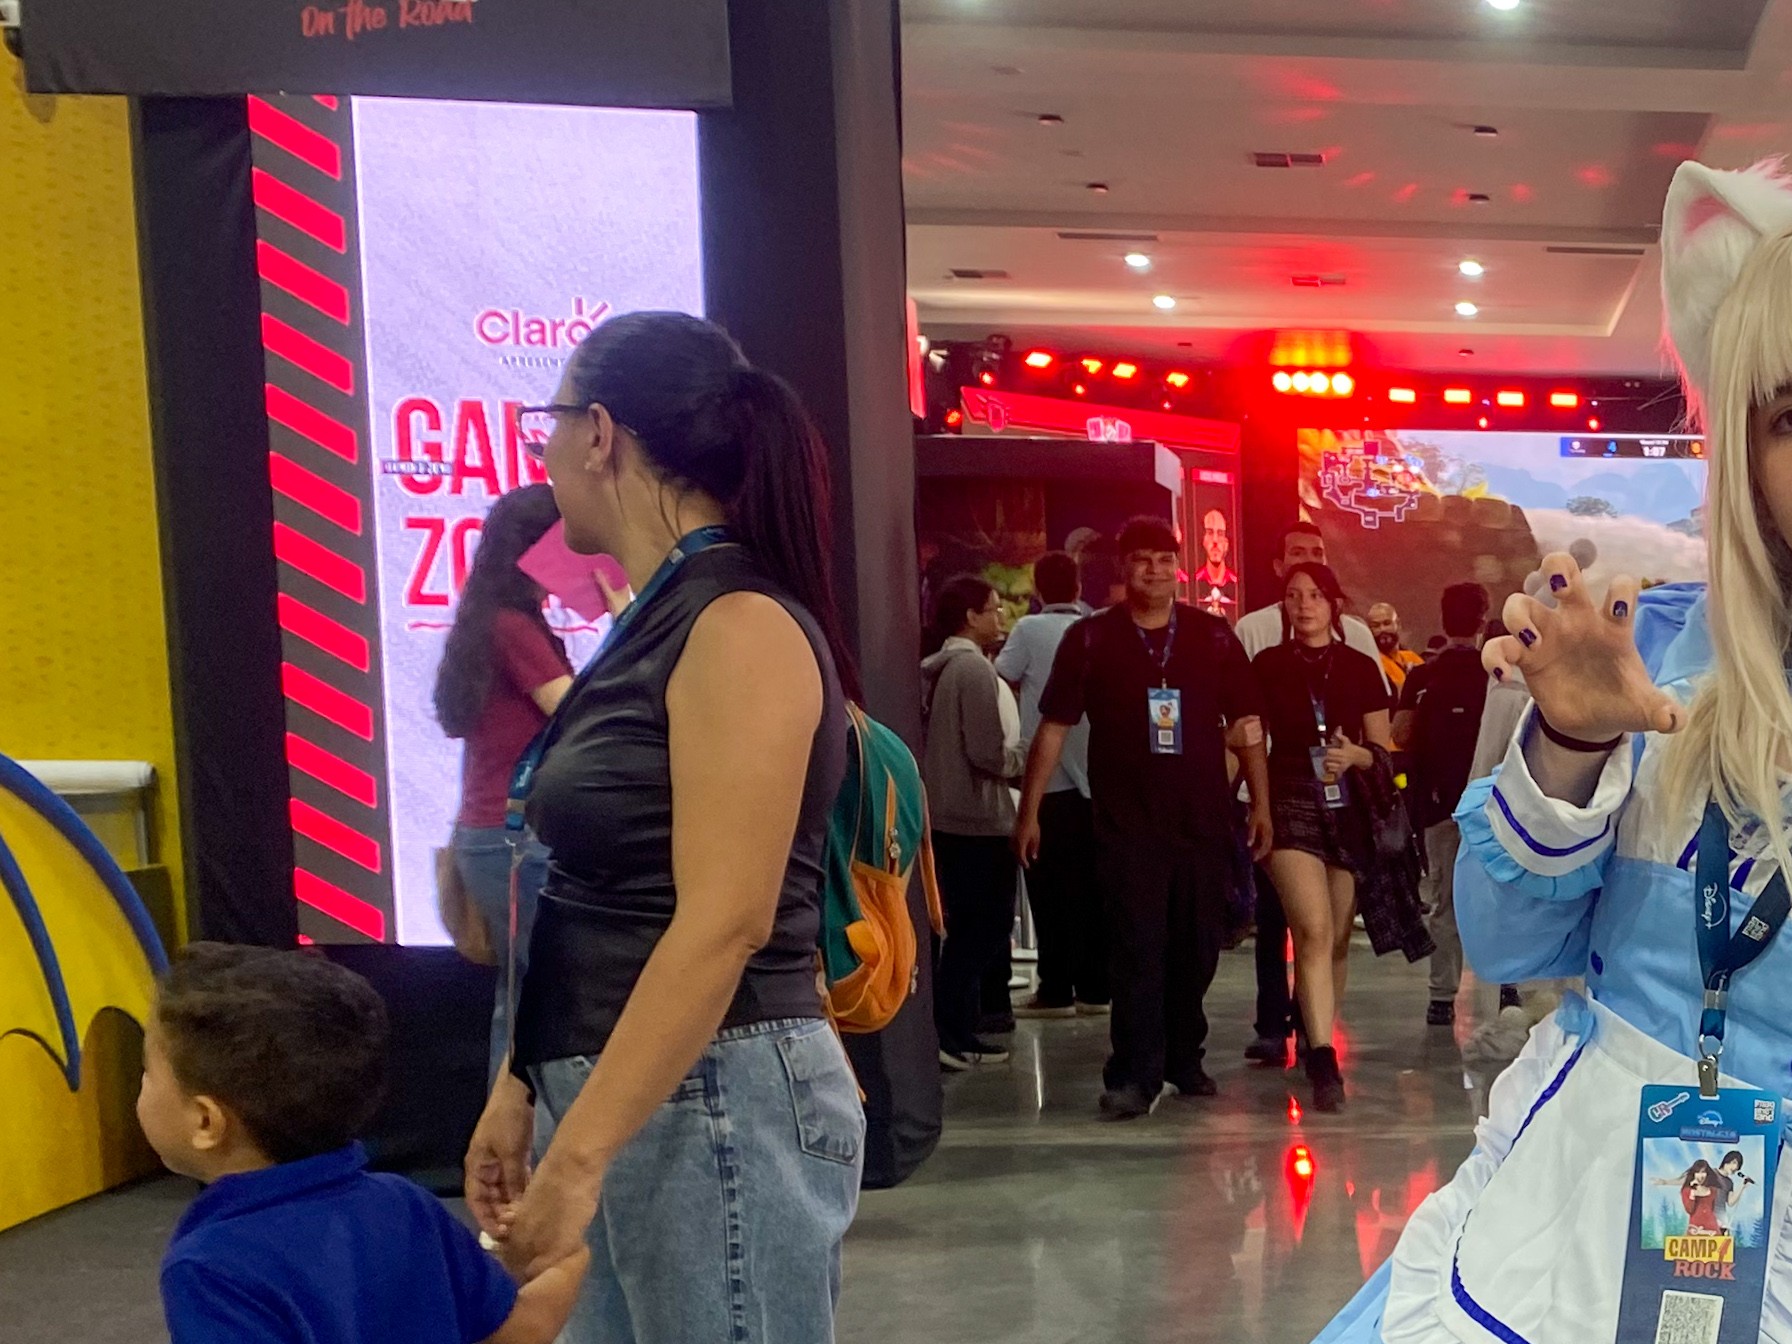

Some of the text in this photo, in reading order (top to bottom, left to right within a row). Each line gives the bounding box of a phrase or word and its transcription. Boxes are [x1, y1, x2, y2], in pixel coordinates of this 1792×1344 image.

[475, 296, 609, 346] Claro
[1669, 1238, 1718, 1258] CAMP
[1673, 1259, 1737, 1280] ROCK
